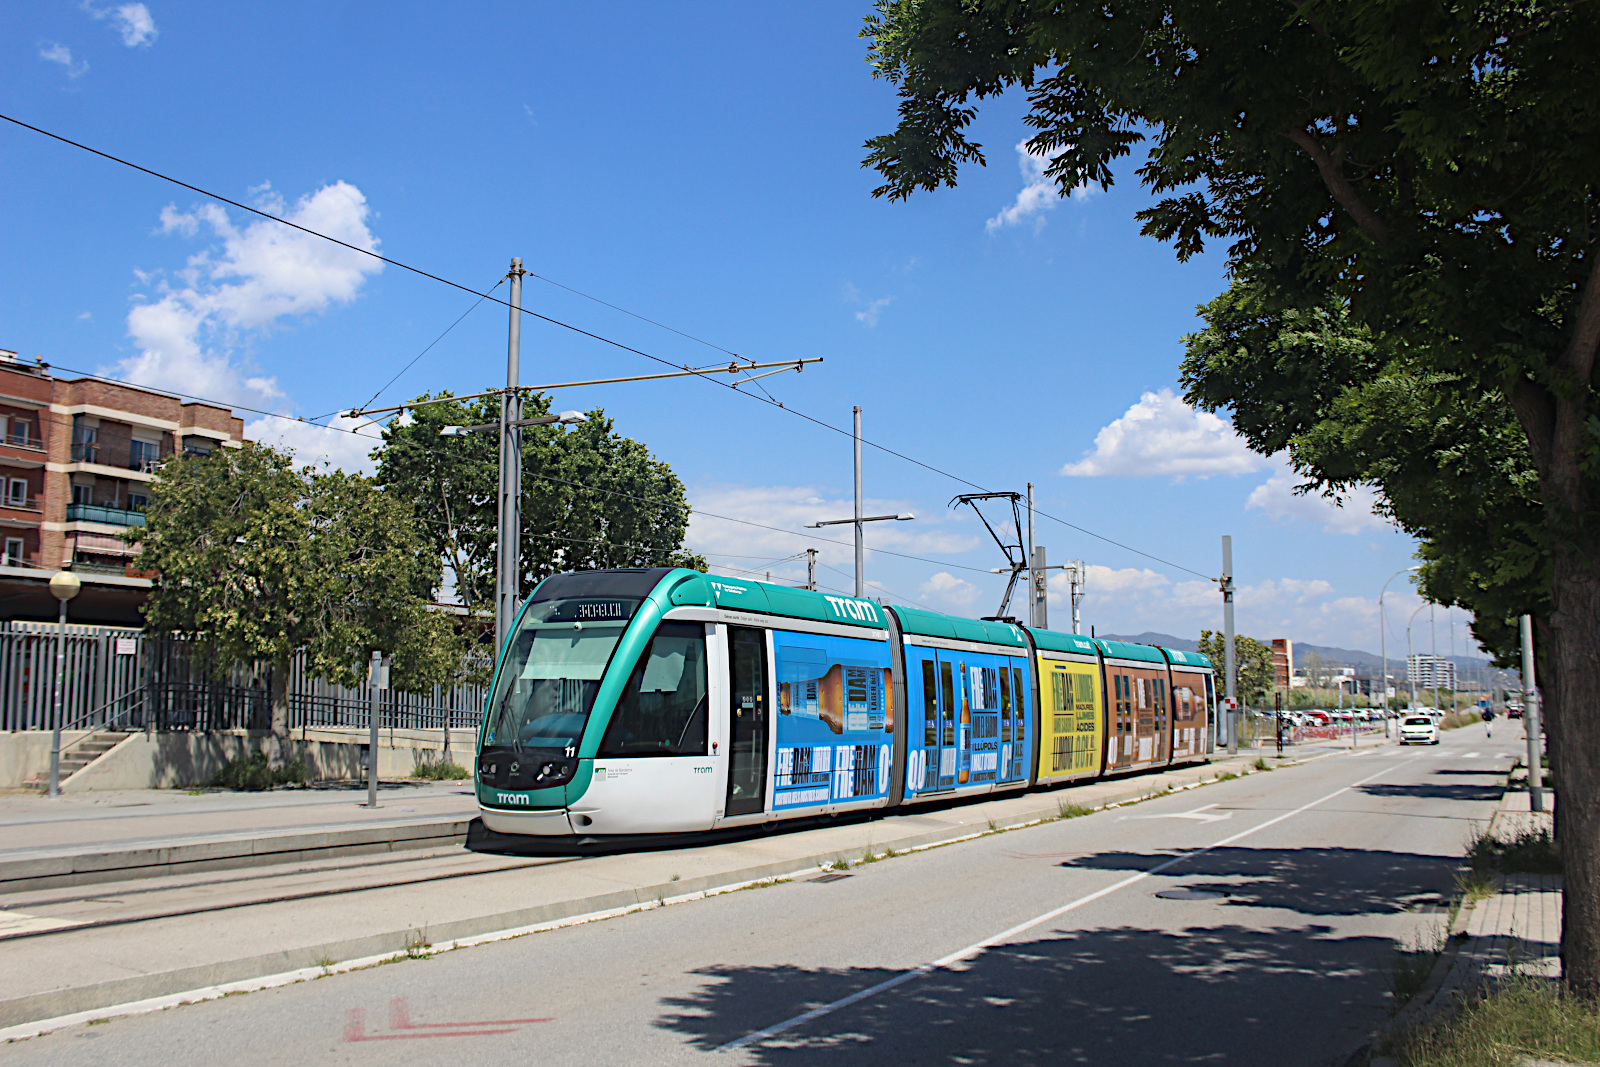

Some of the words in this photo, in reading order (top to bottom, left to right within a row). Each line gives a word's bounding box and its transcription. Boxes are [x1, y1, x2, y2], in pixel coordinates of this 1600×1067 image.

[565, 746, 576, 758] 11
[693, 766, 713, 774] Tram
[496, 793, 530, 805] Tram
